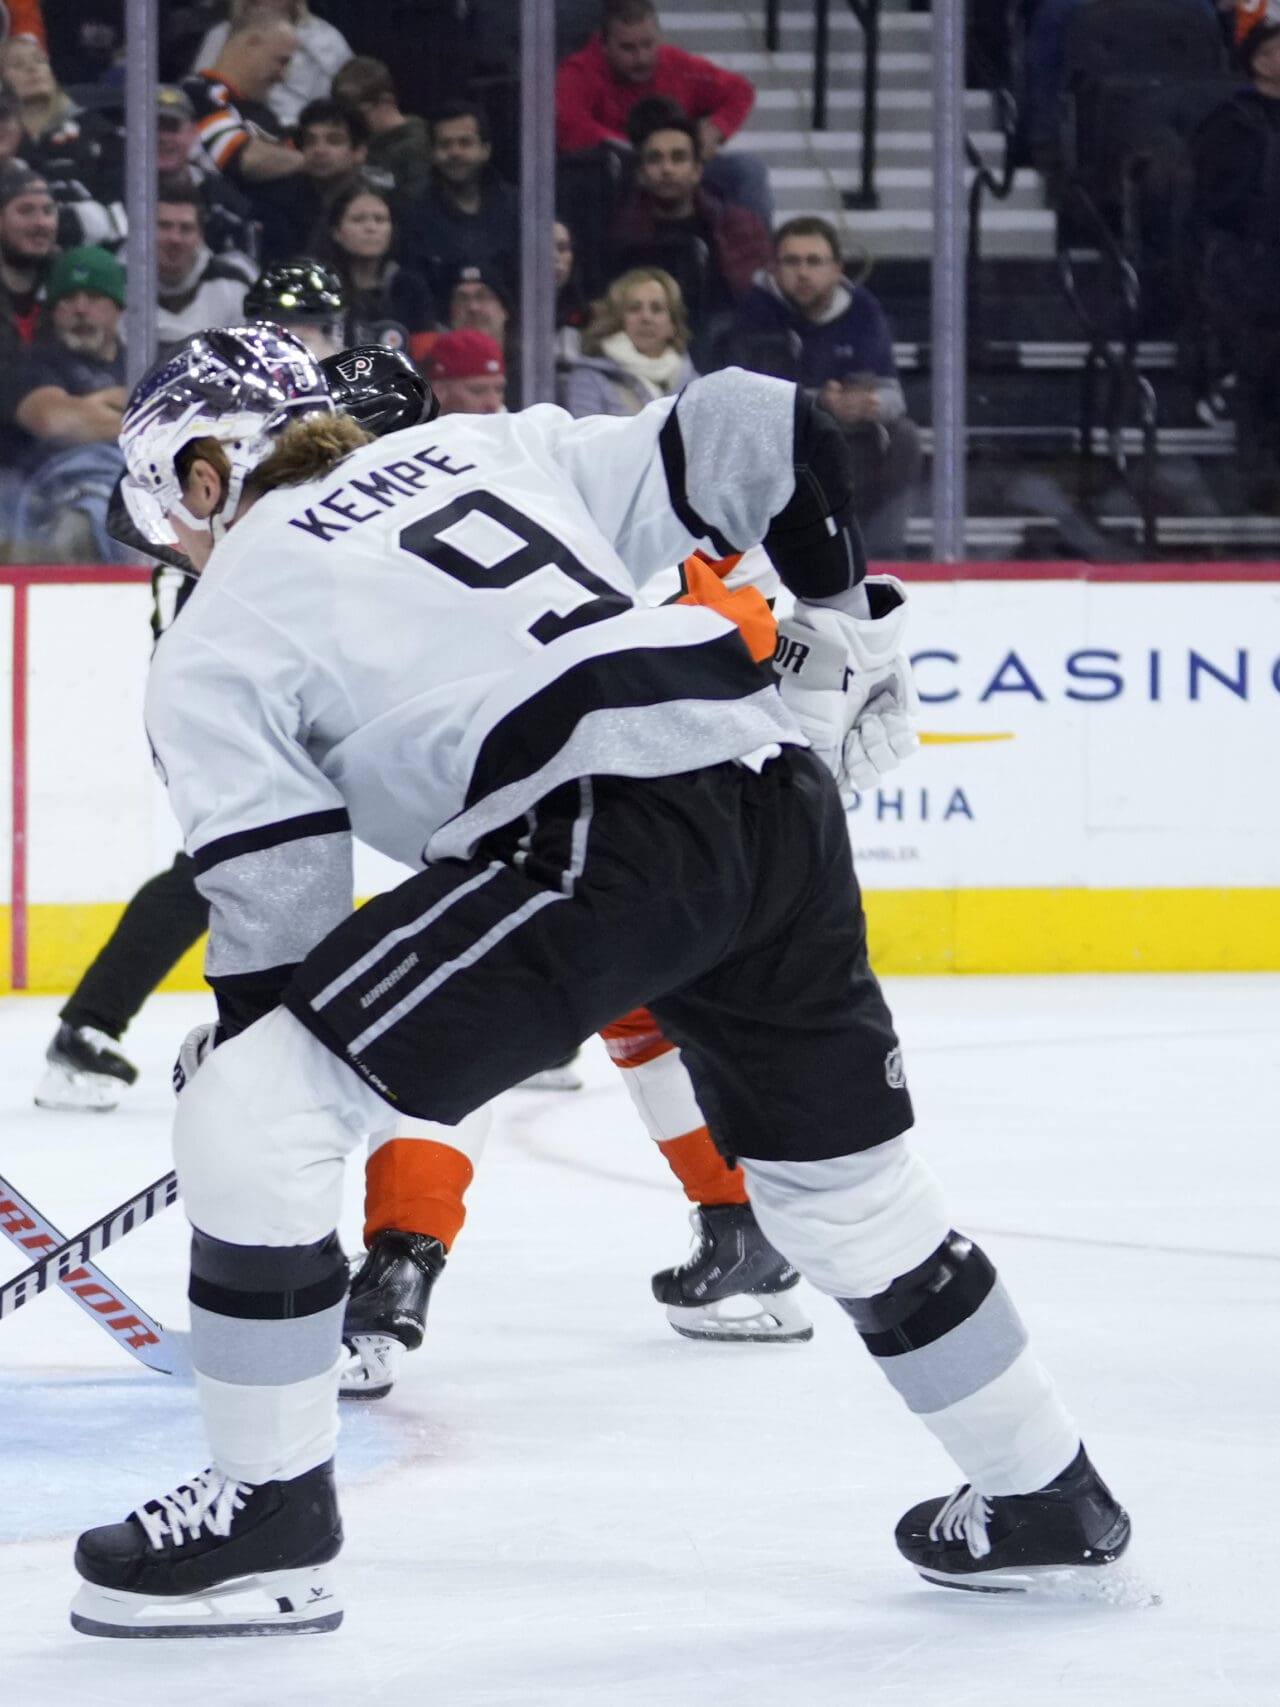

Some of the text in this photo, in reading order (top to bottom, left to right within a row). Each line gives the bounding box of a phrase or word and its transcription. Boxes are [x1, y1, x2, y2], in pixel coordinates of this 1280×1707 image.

[288, 445, 477, 542] KEMPE
[399, 488, 635, 646] 9
[910, 648, 1280, 703] CASIN
[360, 952, 419, 1009] WARRIOR
